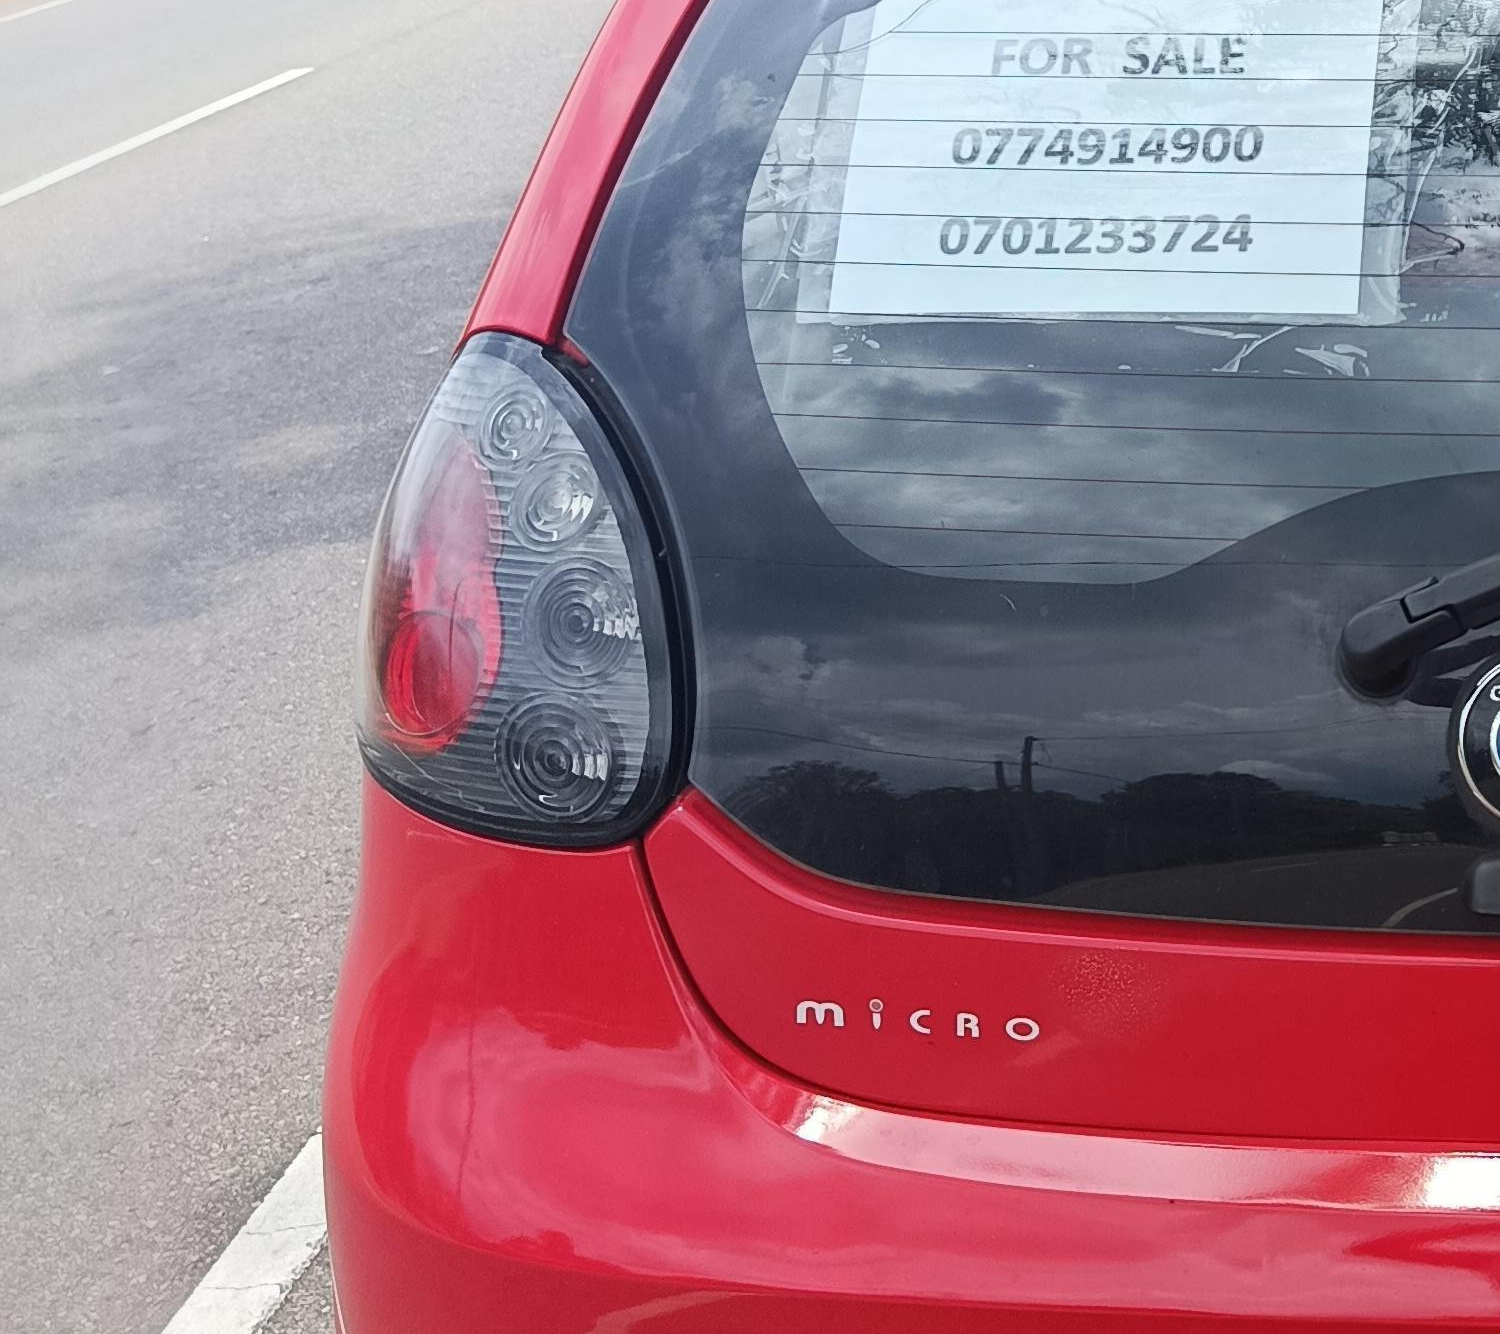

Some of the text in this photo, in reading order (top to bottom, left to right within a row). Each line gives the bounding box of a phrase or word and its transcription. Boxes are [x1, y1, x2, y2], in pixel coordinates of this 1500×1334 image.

[991, 36, 1247, 75] FOR SALE
[951, 125, 1265, 166] 0774914900
[939, 214, 1253, 255] 0701233724
